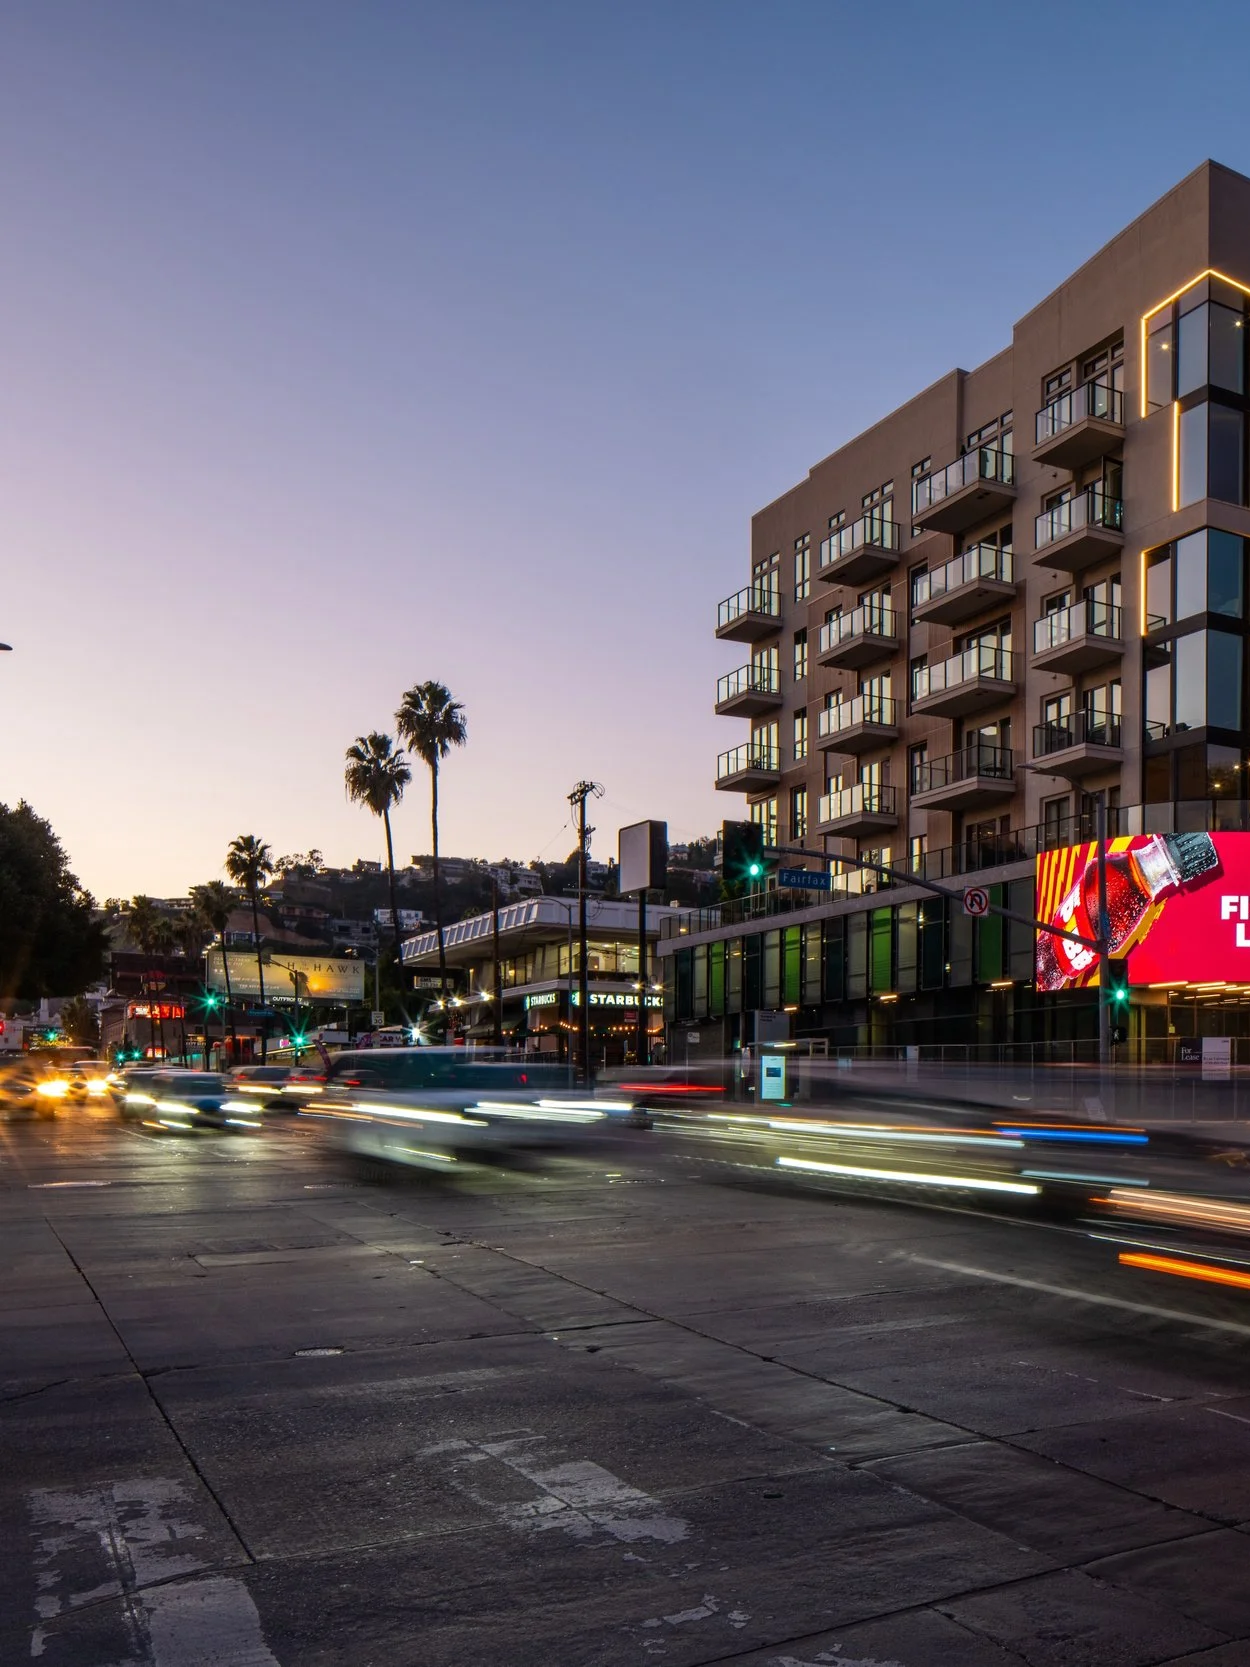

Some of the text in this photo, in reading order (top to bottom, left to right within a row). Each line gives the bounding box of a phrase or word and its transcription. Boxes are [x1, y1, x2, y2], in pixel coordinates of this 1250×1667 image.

[783, 872, 826, 886] Fairfax
[530, 994, 556, 1006] STARBUCKS
[589, 994, 663, 1007] STARBCK
[1181, 1046, 1192, 1054] For
[1181, 1052, 1200, 1061] Lease
